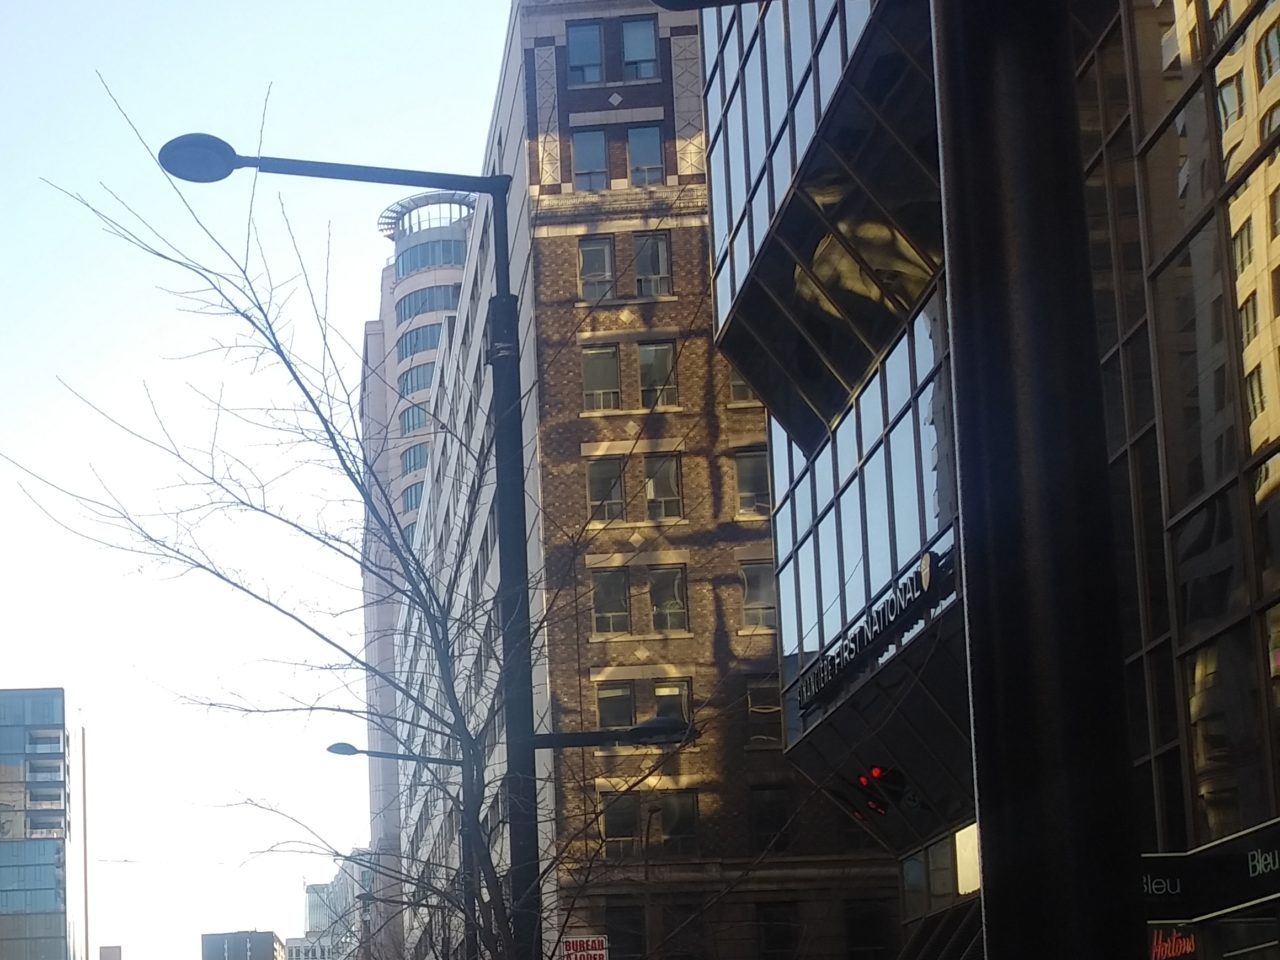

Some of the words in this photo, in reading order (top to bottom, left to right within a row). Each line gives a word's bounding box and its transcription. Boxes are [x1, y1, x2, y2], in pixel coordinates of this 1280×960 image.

[833, 629, 860, 675] FIRST
[863, 571, 921, 646] NATIONAL
[1248, 849, 1279, 878] Bleu
[565, 940, 604, 951] BUREAU
